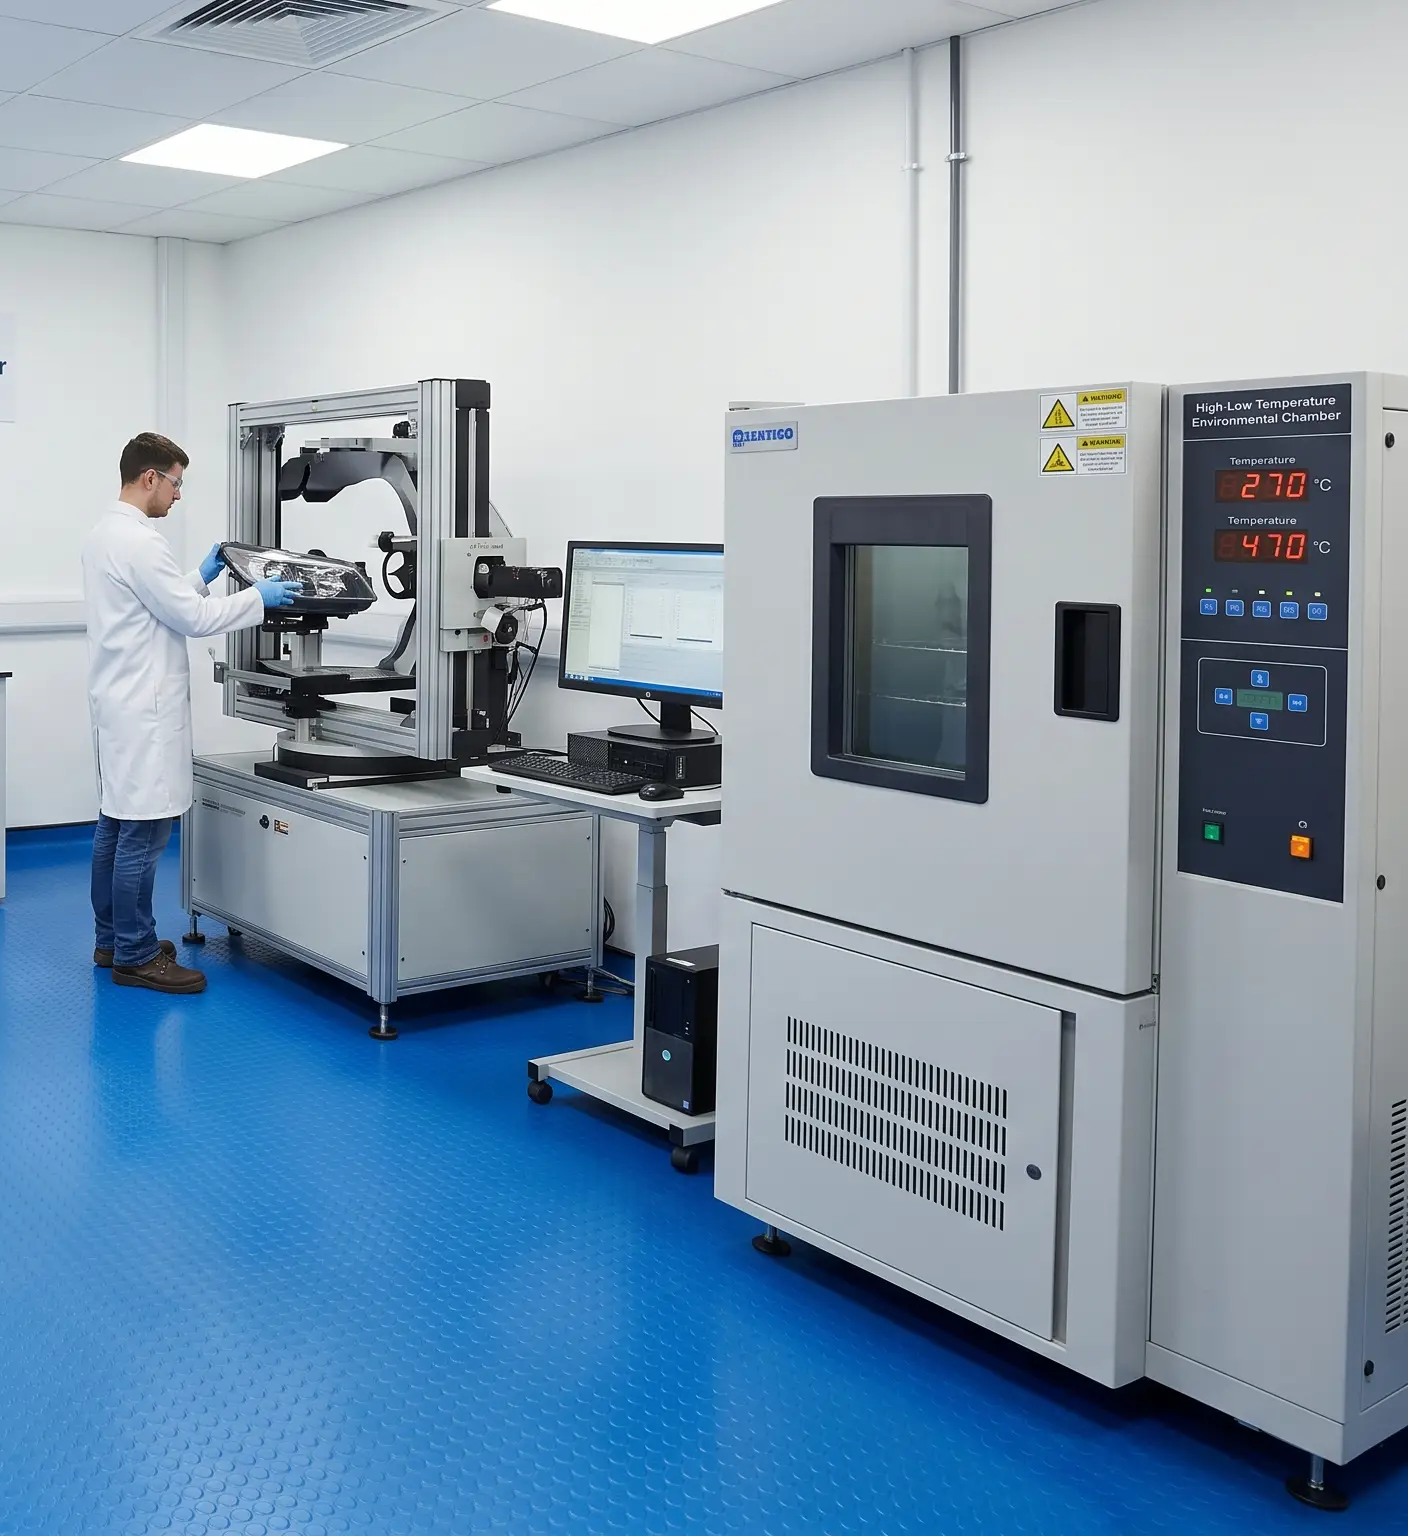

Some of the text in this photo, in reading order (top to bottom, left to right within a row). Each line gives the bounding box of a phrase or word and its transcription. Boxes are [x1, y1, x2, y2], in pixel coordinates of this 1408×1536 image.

[1196, 396, 1337, 415] High-Low Temperature
[1192, 410, 1342, 428] Environmental Chamber
[1229, 456, 1296, 467] Temperature
[1241, 472, 1307, 499] 270
[1313, 478, 1332, 492] °C
[1228, 516, 1297, 527] Temperature
[1241, 533, 1306, 560] 470
[1313, 540, 1332, 554] °C
